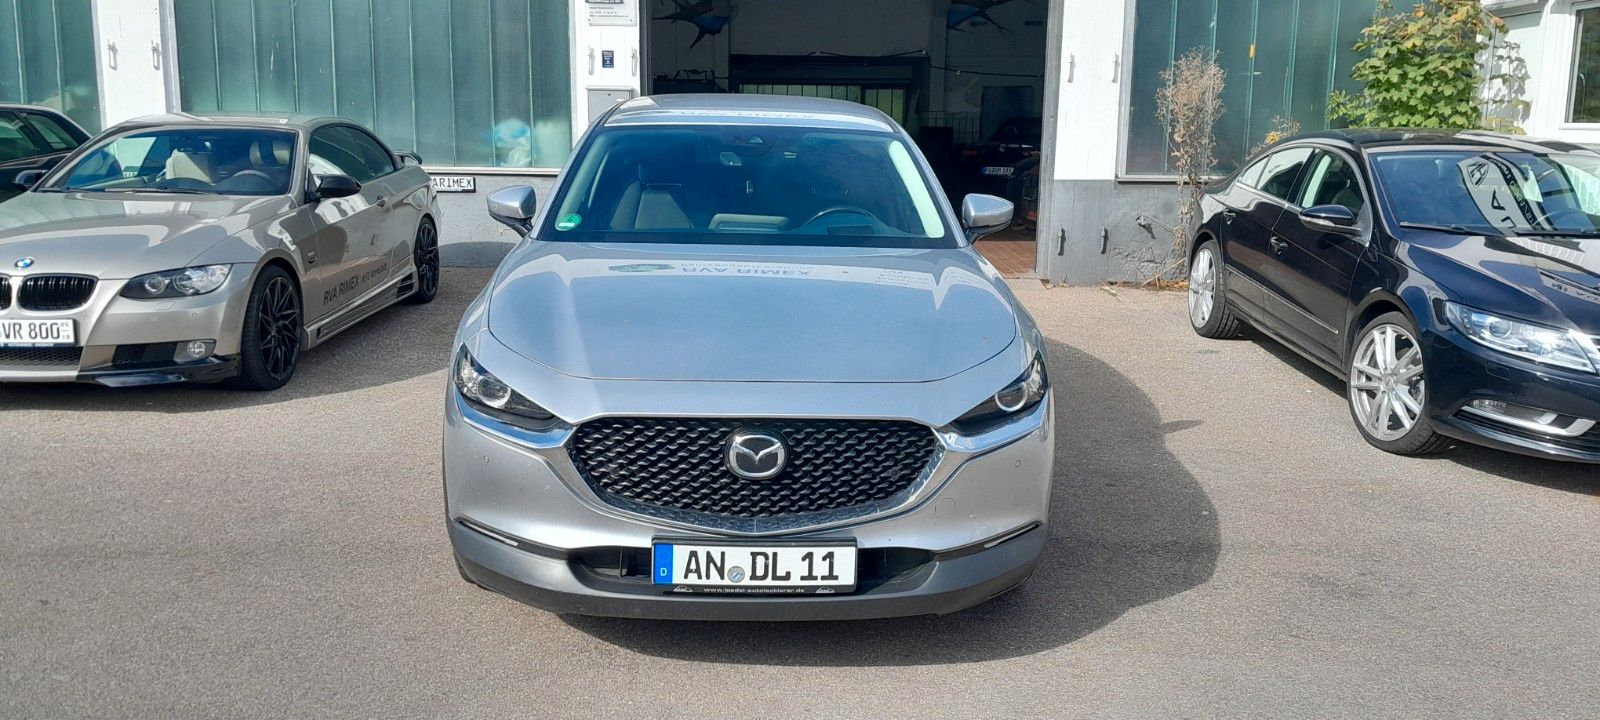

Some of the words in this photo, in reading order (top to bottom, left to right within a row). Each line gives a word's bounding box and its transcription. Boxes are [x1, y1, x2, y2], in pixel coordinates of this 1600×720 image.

[323, 286, 338, 306] RVA
[2, 322, 23, 339] VR
[28, 322, 60, 340] 800
[660, 567, 668, 577] D
[683, 550, 726, 580] AN
[750, 551, 791, 581] DL
[800, 551, 839, 581] 11
